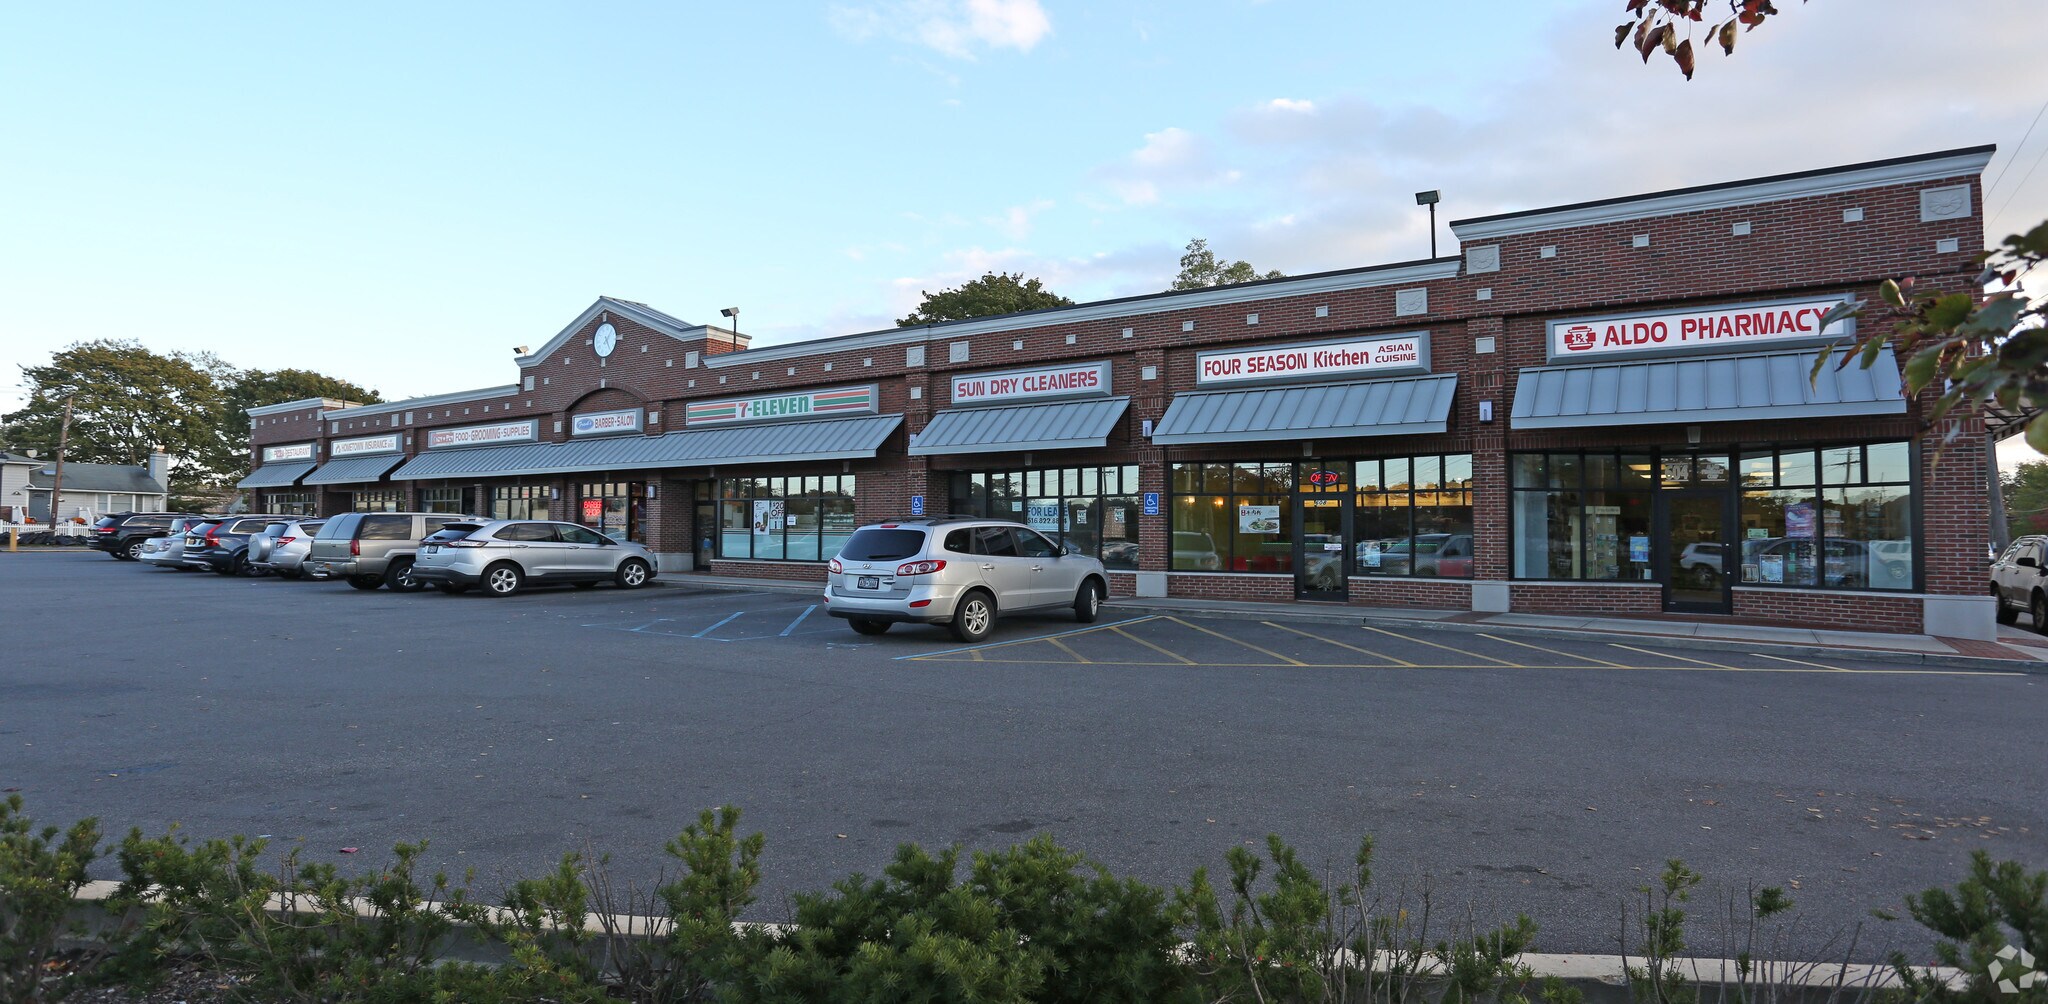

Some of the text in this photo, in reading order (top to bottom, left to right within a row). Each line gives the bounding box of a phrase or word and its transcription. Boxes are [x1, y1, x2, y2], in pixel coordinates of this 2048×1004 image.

[1603, 307, 1831, 347] ALDO PHARMACY
[1374, 352, 1417, 363] CUISINE
[1378, 343, 1413, 353] ASIAN
[1204, 349, 1370, 377] FOUR SEASON Kitchen
[957, 370, 1098, 398] SUN DRY CLEANERS
[1027, 506, 1042, 516] FOR
[1043, 507, 1068, 517] LEAE
